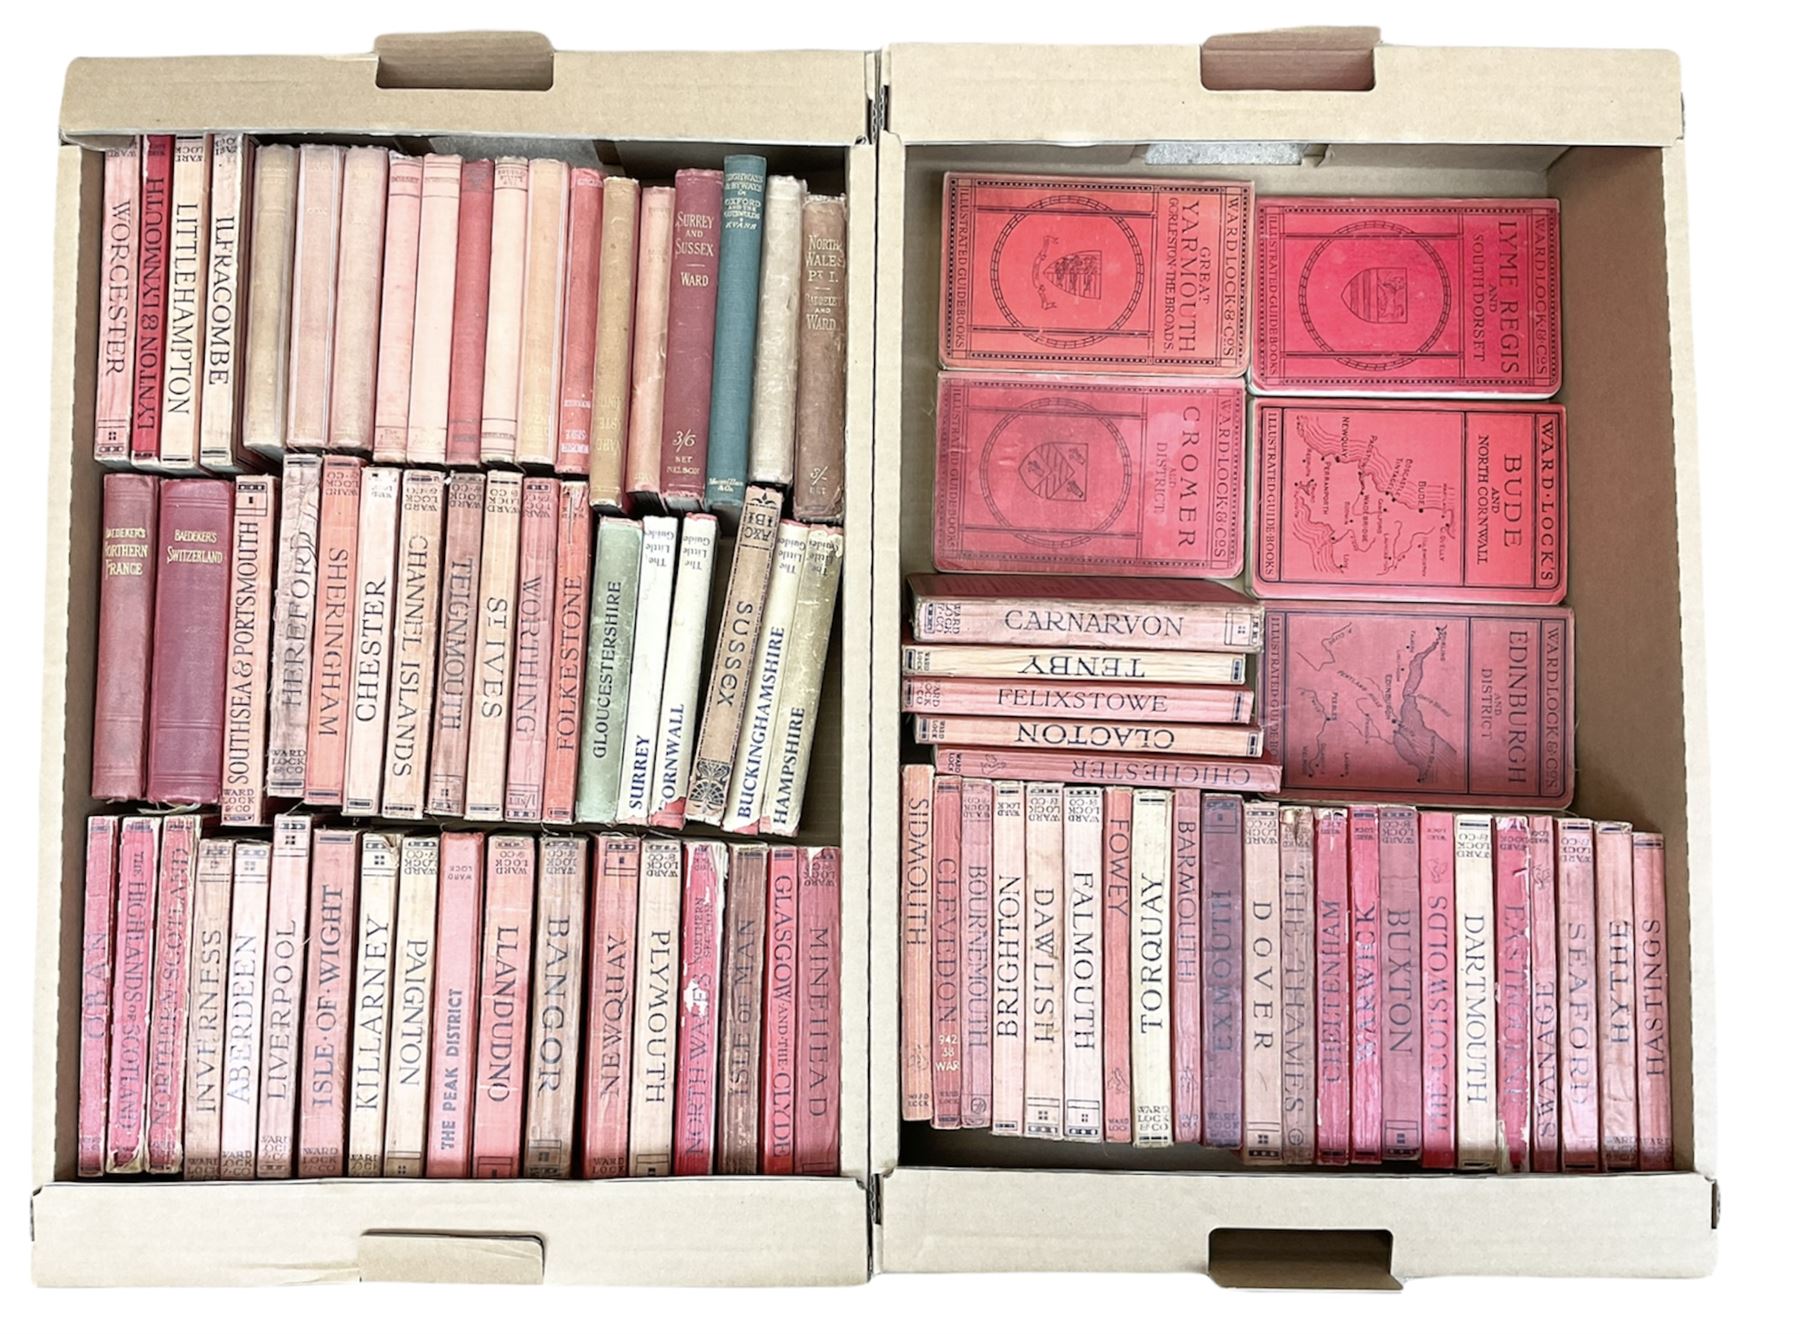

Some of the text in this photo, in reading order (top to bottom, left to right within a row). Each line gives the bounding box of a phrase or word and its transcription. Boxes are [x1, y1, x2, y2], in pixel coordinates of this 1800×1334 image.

[143, 176, 165, 310] LYNMOUTH
[676, 238, 715, 257] SUSSEX
[677, 211, 715, 230] SURREY
[685, 230, 703, 238] AND
[724, 198, 761, 208] OXFORD
[808, 235, 842, 252] NORTH
[958, 188, 968, 265] ILLUSTRATED
[1224, 197, 1239, 305] WARD LOCK
[1269, 216, 1277, 293] ILLUSTRATED
[105, 200, 131, 377] WORCESTER
[167, 203, 199, 415] LITTLEHAMPTON
[208, 216, 235, 385] ILFRACOMBE
[680, 272, 709, 287] WARD
[805, 252, 844, 267] WALES
[1165, 270, 1176, 295] THE
[1179, 200, 1199, 352] YARMOUTH
[1199, 247, 1211, 305] GREAT
[1472, 234, 1485, 362] SOUTH DORSET
[1489, 284, 1498, 313] AND
[1498, 222, 1519, 374] LYME REGIS
[1534, 218, 1547, 325] WARD LOCK
[806, 314, 837, 331] WARD
[136, 334, 158, 430] LYNTON
[667, 465, 700, 475] NELSON
[673, 429, 697, 453] 3/6
[1178, 406, 1200, 547] CROMER
[1216, 399, 1232, 508] WARD LOCK
[1323, 461, 1331, 515] PERRANPORTH
[1340, 416, 1349, 458] NEWQUAY
[174, 529, 217, 544] BAEDEKER'S
[645, 543, 670, 553] Little
[1265, 412, 1277, 575] ILLUSTRATED GUIDE BOOKS
[1362, 494, 1370, 543] WADEBRIDGE
[1418, 481, 1426, 506] BUDE
[1477, 435, 1489, 565] NORTH CORNWALL
[1492, 487, 1500, 514] AND
[1504, 454, 1522, 547] BUDE
[1541, 420, 1554, 580] WARD LOCK'S
[105, 561, 144, 579] FRANCE
[167, 547, 223, 565] SWITZERLAND
[648, 557, 666, 567] The
[683, 548, 707, 558] Little
[684, 561, 701, 570] The
[779, 551, 802, 561] Little
[779, 564, 797, 574] The
[228, 521, 259, 784] SOUTHSEA & PORTSMOUTH
[282, 532, 314, 707] HEREFORD
[318, 548, 349, 737] SHERINGHAM
[355, 578, 387, 721] CHESTER
[392, 535, 430, 777] CHANNEL ISLANDS
[442, 558, 473, 731] TEIGNMOUTH
[515, 576, 542, 733] WORTHING
[556, 576, 582, 751] FOLKESTONE
[592, 581, 621, 758] GLOUCESTERSHIRE
[717, 601, 754, 706] SUSSEX
[1004, 609, 1185, 637] CARNARVON
[1017, 654, 1146, 678] TENBY
[1271, 617, 1280, 696] ILLUSTRATED
[481, 641, 505, 718] IVES
[738, 626, 785, 820] BUCKINGHAMSHIRE
[997, 688, 1168, 713] FELIXSTOWE
[1331, 692, 1339, 721] PEEBLES
[1384, 674, 1393, 720] EDINBURGH
[1481, 669, 1493, 741] DISTRICT
[1494, 694, 1502, 716] AND
[1508, 631, 1528, 783] EDINBURGH
[1546, 627, 1559, 736] WARD LOCK
[271, 757, 306, 766] LOCK
[628, 734, 651, 810] SURREY
[772, 707, 805, 824] HAMPSHIRE
[1014, 722, 1174, 750] CLACTON
[1072, 759, 1251, 785] CHICHESTER
[496, 859, 528, 867] LOCK
[496, 867, 528, 875] WARD
[646, 869, 679, 878] WARD
[906, 798, 930, 945] SIDMOUTH
[1108, 817, 1130, 917] FOWEY
[1175, 820, 1197, 977] BARMOUTH
[1457, 842, 1490, 850] LOCK
[688, 897, 705, 965] NORTHERN
[935, 858, 959, 1024] CLEVEDON
[996, 874, 1021, 1038] BRIGHTON
[1140, 873, 1163, 1034] TORQUAY
[1284, 866, 1305, 938] THE
[84, 932, 107, 1040] OBAN
[117, 851, 147, 1132] THE HIGHLANDS OF SCOTLAND
[267, 919, 297, 1099] LIVERPOOL
[313, 884, 343, 1106] ISLE OF WIGHT
[536, 915, 570, 1099] BANGOR
[730, 918, 755, 1096] ISLE OF MAN
[966, 865, 989, 1049] BOURNEMOUTH
[1033, 888, 1055, 1043] DAWLISH
[1072, 871, 1095, 1050] FALMOUTH
[1210, 890, 1233, 1053] EXMOUTH
[1252, 901, 1273, 1051] DOVER
[1322, 900, 1341, 1084] CHELTENHAM
[1355, 903, 1377, 1064] WARWICK
[1386, 910, 1412, 1054] BUXTON
[1428, 895, 1448, 1069] COTSWOLDS
[1464, 915, 1488, 1104] DARTMOUTH
[1609, 920, 1631, 1044] HYTHE
[1643, 919, 1665, 1076] HASTINGS
[195, 929, 222, 1112] INVERNESS
[226, 935, 257, 1104] ABERDEEN
[355, 914, 389, 1110] KILLARNEY
[400, 939, 428, 1086] PAIGNTON
[486, 925, 518, 1103] LLANDUDNO
[600, 935, 628, 1097] NEWQUAY
[645, 931, 671, 1104] PLYMOUTH
[772, 876, 793, 1157] GLASGOW AND THE CLYDE
[807, 927, 829, 1117] MINEHEAD
[935, 1060, 960, 1072] WAR
[938, 1035, 959, 1045] 942
[1283, 962, 1305, 1113] THAMES
[1535, 980, 1557, 1138] SWANAGE
[1567, 923, 1591, 1106] SEAFORD
[440, 988, 463, 1150] THE PEAK DISTRICT
[686, 1068, 707, 1155] NORTH
[593, 1157, 625, 1165] WARD
